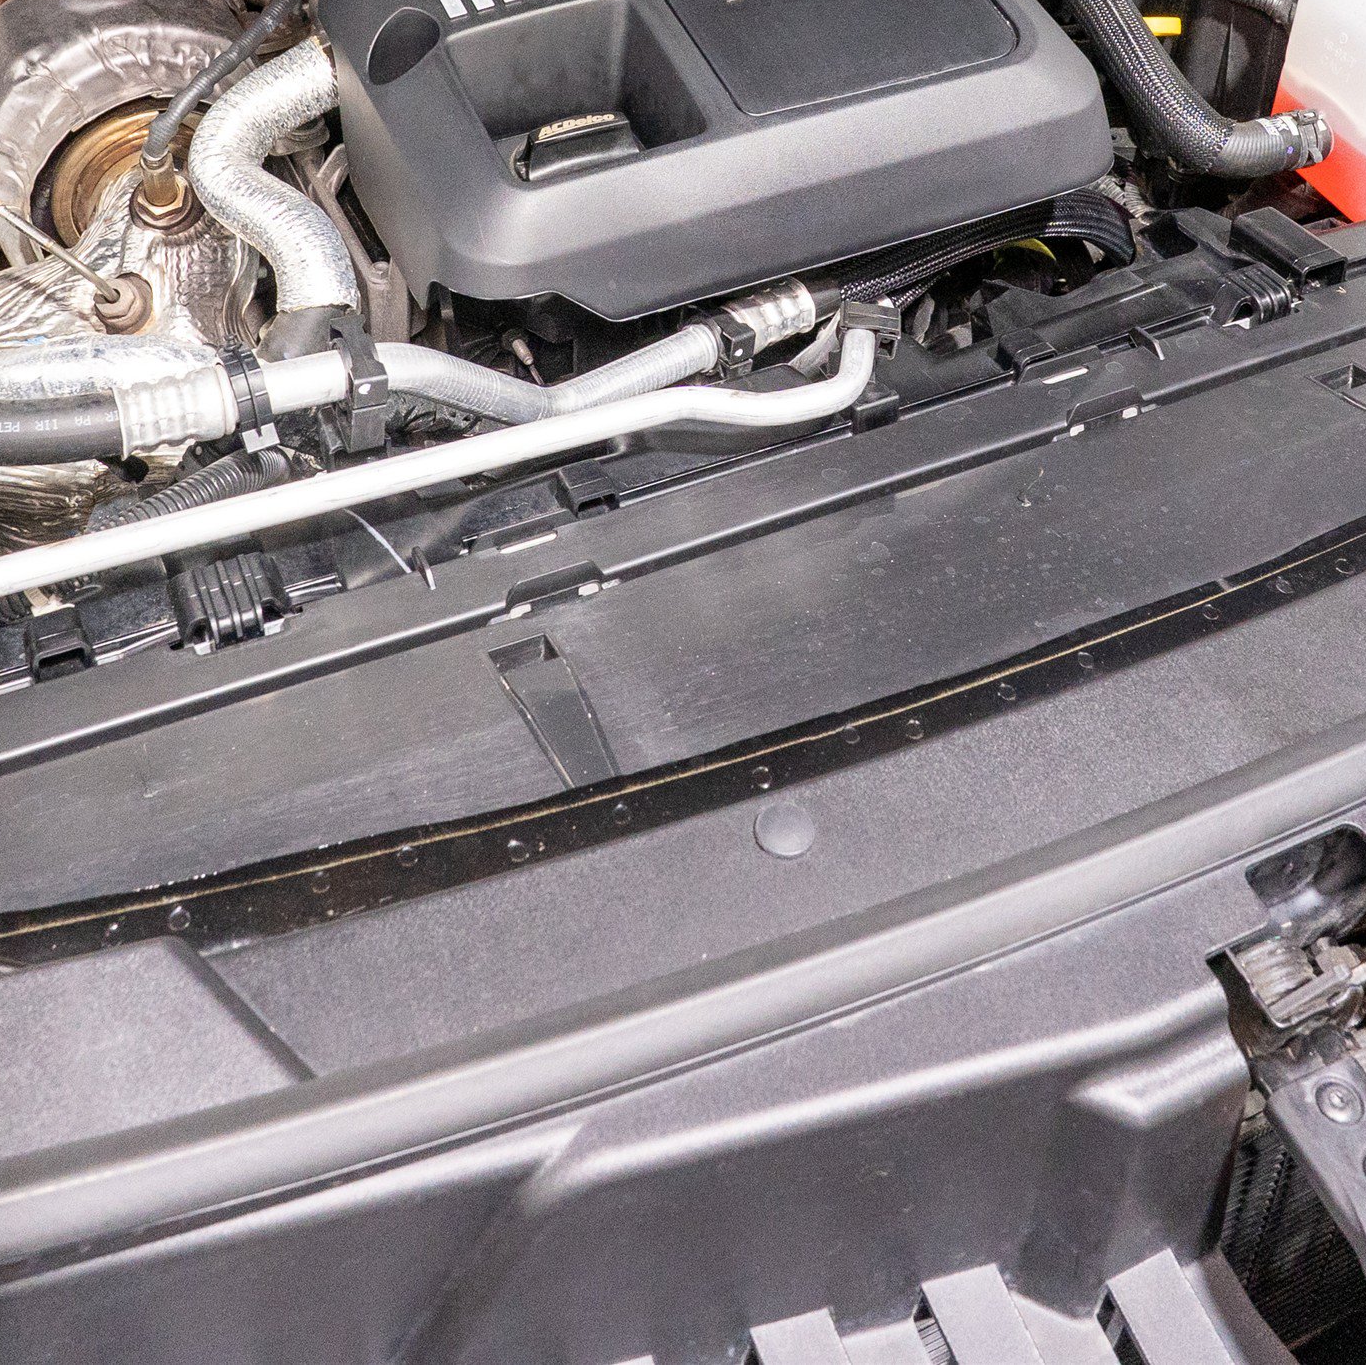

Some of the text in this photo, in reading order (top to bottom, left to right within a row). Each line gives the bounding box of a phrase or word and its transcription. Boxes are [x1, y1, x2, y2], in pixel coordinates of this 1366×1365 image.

[538, 114, 615, 140] ACDelco
[35, 418, 58, 431] IIR
[74, 415, 91, 426] PA
